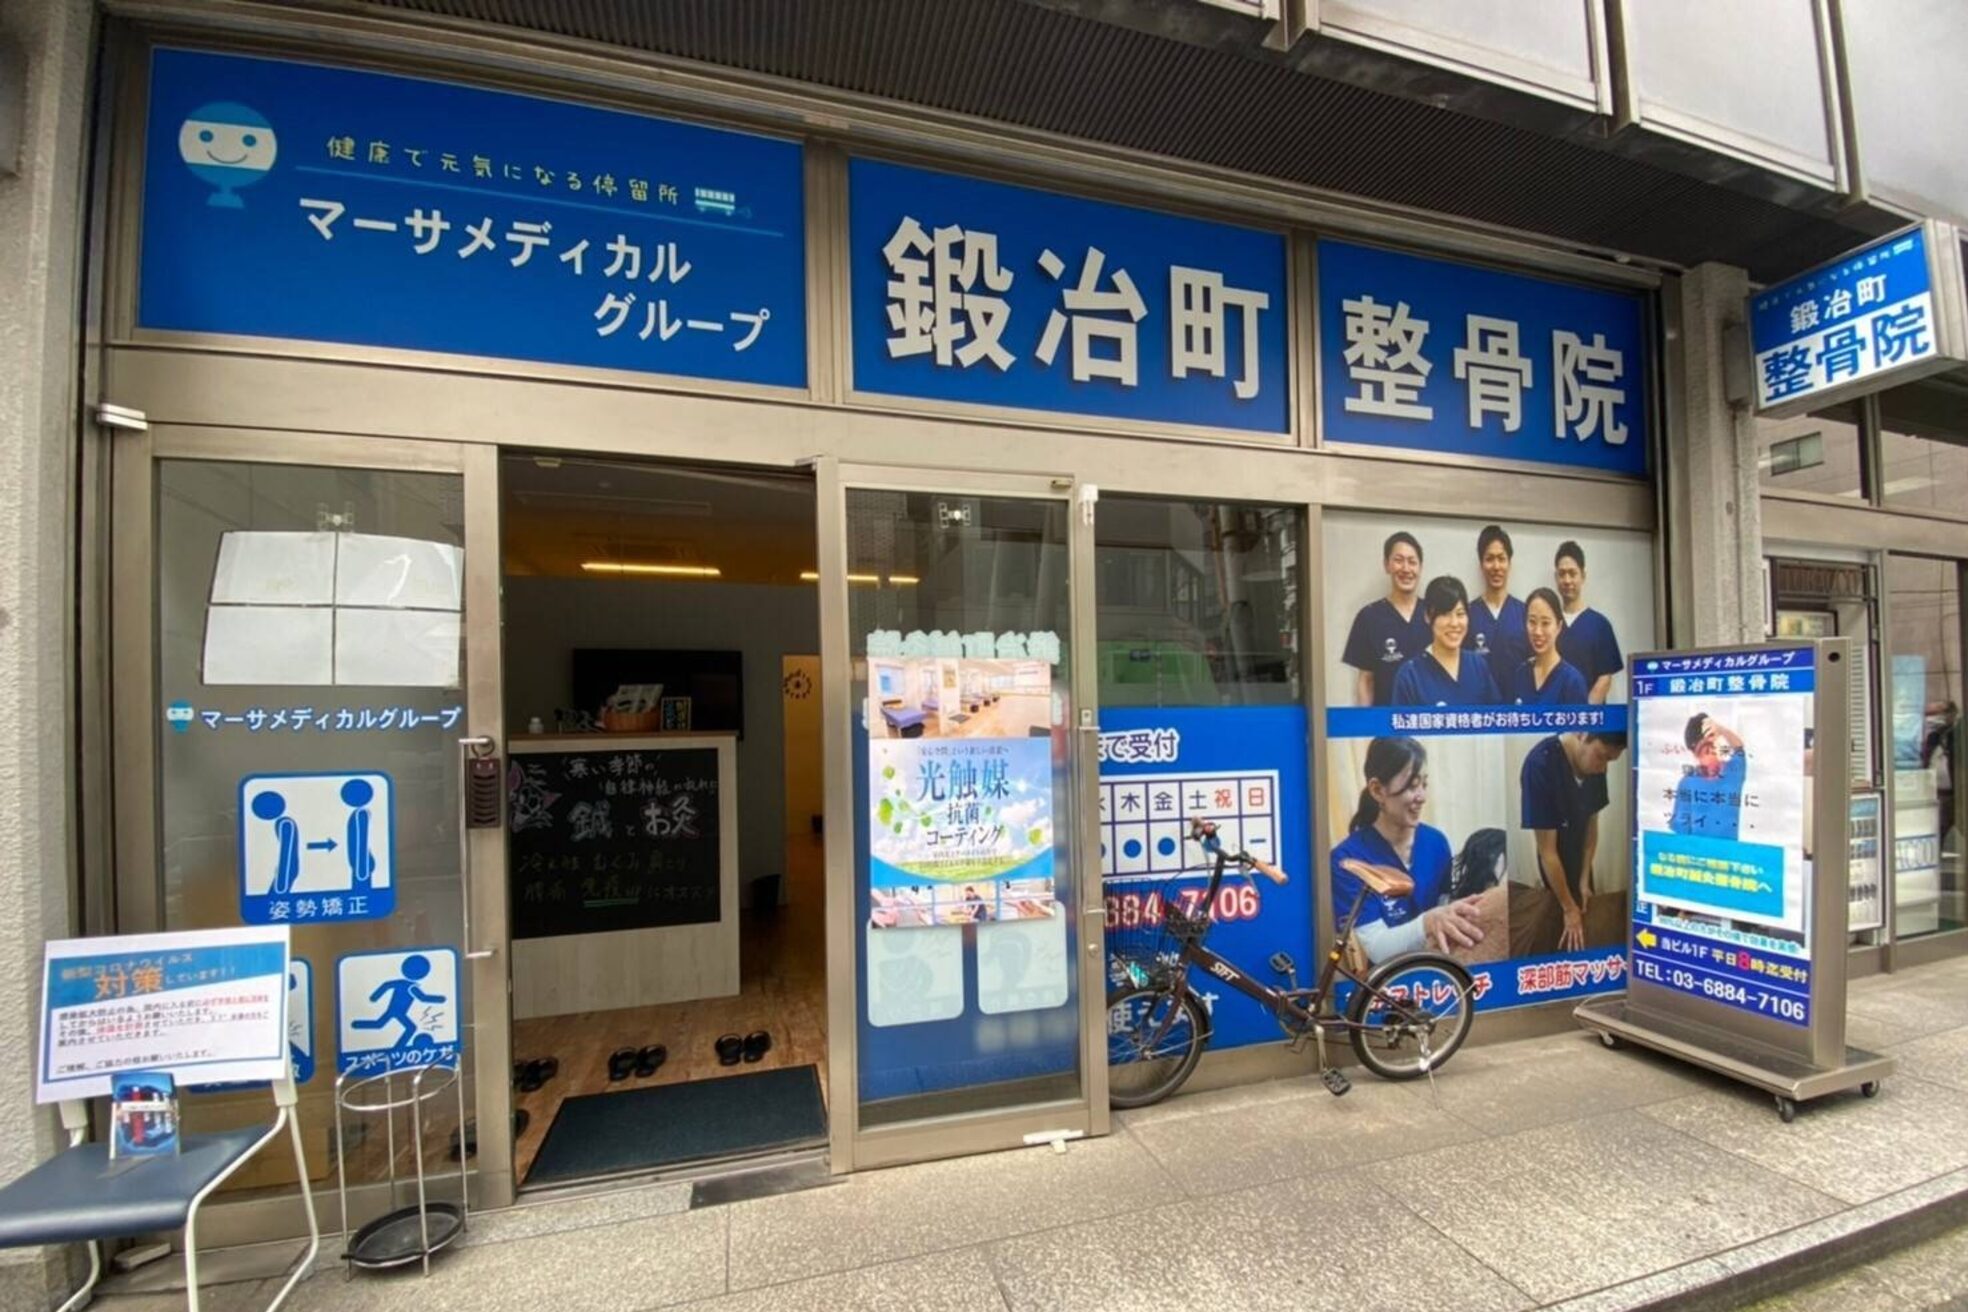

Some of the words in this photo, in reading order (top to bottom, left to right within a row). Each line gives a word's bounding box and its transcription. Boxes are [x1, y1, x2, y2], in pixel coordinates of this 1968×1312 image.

[326, 135, 679, 206] 健康で元気になる停留所
[300, 197, 693, 285] マーサメディカル
[1789, 273, 1887, 335] 鍛冶町
[593, 292, 770, 352] グループ
[881, 214, 1270, 400] 鍛冶町
[1341, 293, 1629, 446] 整骨院
[1762, 303, 1931, 403] 整骨院
[1661, 651, 1796, 671] マーサメディカルグループ
[1636, 680, 1653, 695] 1F
[1669, 672, 1790, 693] 鍛冶町整骨院
[200, 705, 463, 731] マーサメディカルグループ
[1391, 711, 1604, 730] 私達国家資格者がお待ちしております!
[916, 759, 1010, 802] 光触媒
[946, 802, 981, 826] 抗菌
[1121, 791, 1141, 813] 木
[1154, 791, 1173, 812] 金
[1188, 790, 1208, 810] 土
[1214, 788, 1233, 809] 祝
[1248, 787, 1265, 807] 日
[925, 825, 1003, 848] コーティング
[268, 895, 369, 921] 姿勢矯正
[93, 966, 164, 999] 対策
